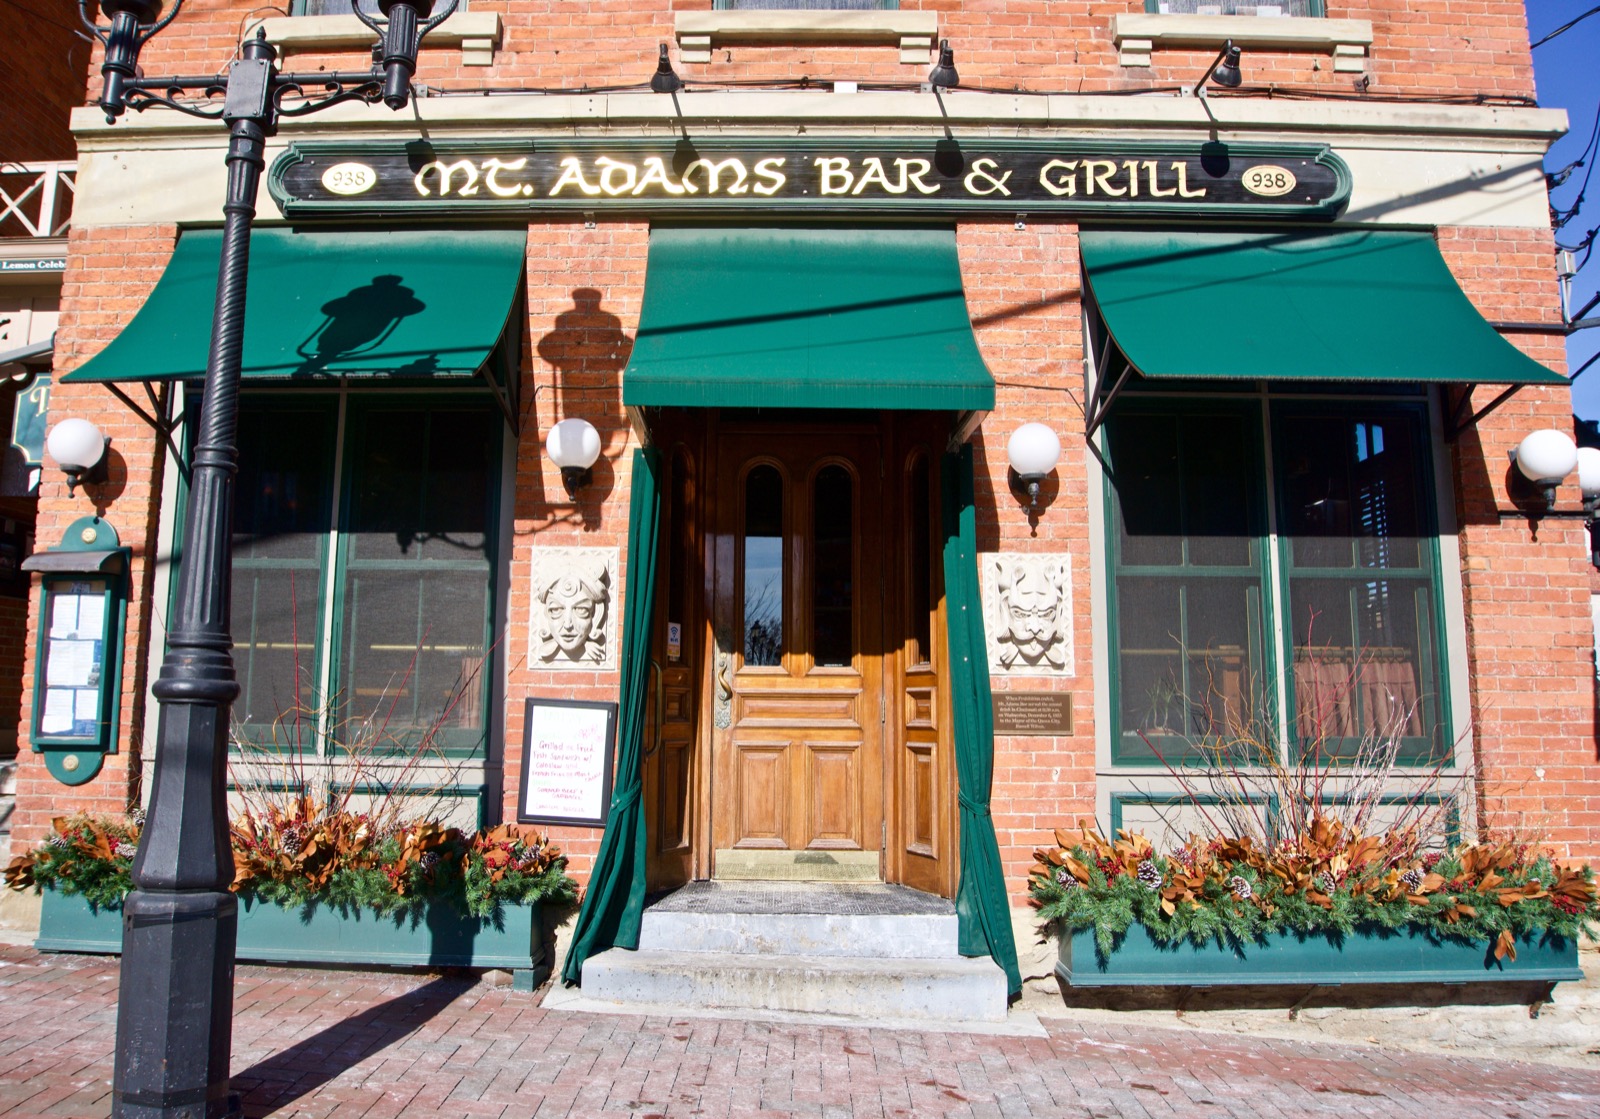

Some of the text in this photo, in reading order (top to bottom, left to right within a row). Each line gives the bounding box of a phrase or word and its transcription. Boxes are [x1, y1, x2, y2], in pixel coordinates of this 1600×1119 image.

[332, 171, 366, 187] 938
[548, 156, 787, 197] ADAMS
[813, 157, 941, 196] BAR
[963, 157, 1013, 197] &
[1039, 158, 1207, 198] GRILL
[1251, 172, 1287, 189] 938
[2, 260, 67, 270] Lemon Celeb
